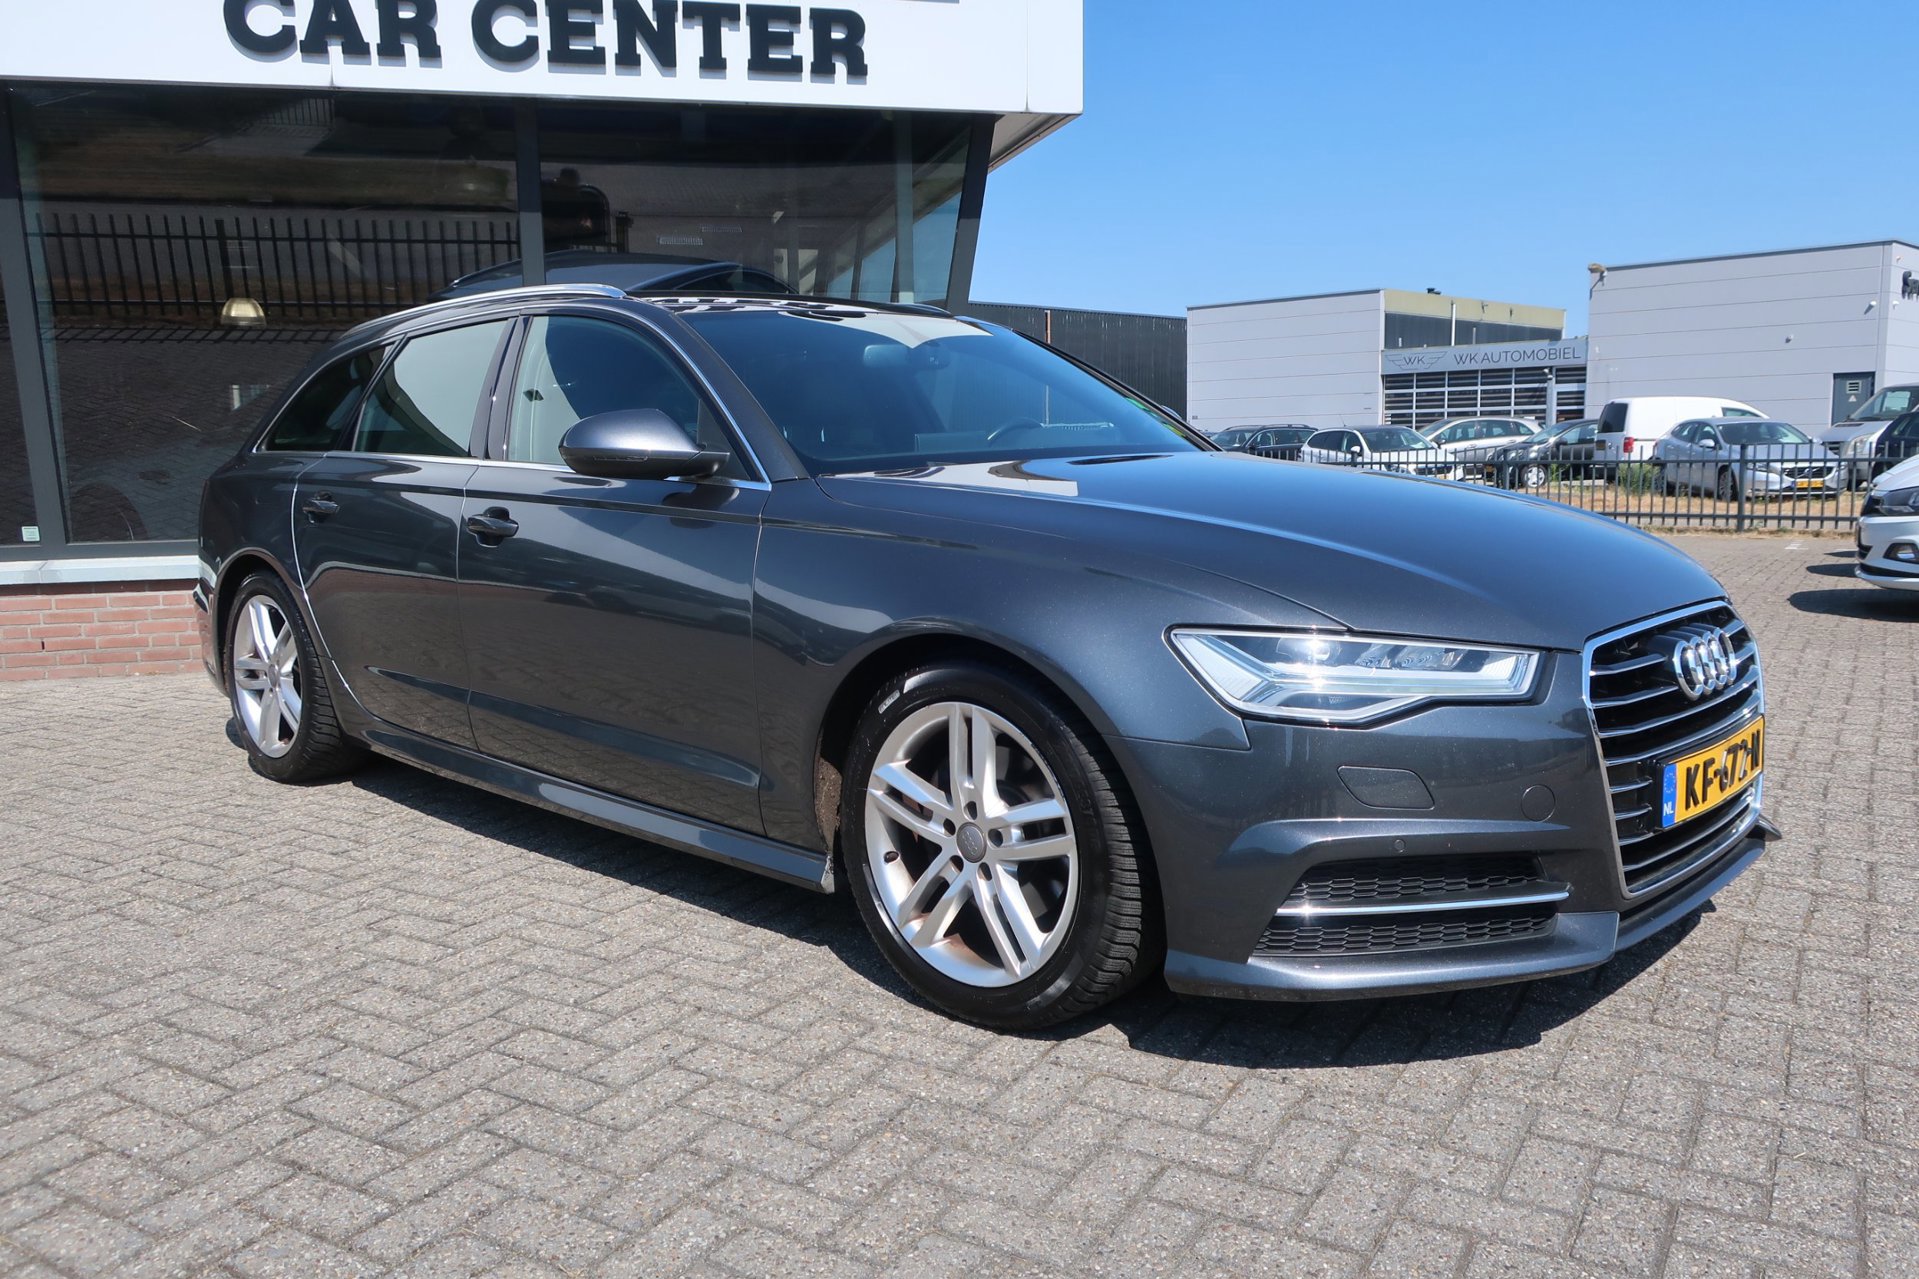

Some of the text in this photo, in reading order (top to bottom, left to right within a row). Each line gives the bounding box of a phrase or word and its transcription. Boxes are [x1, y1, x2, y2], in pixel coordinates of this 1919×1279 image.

[223, 0, 868, 76] CAR CENTER
[1403, 355, 1426, 366] WK
[1453, 346, 1582, 365] WK AUTOMOBIEL
[1663, 801, 1674, 817] NL
